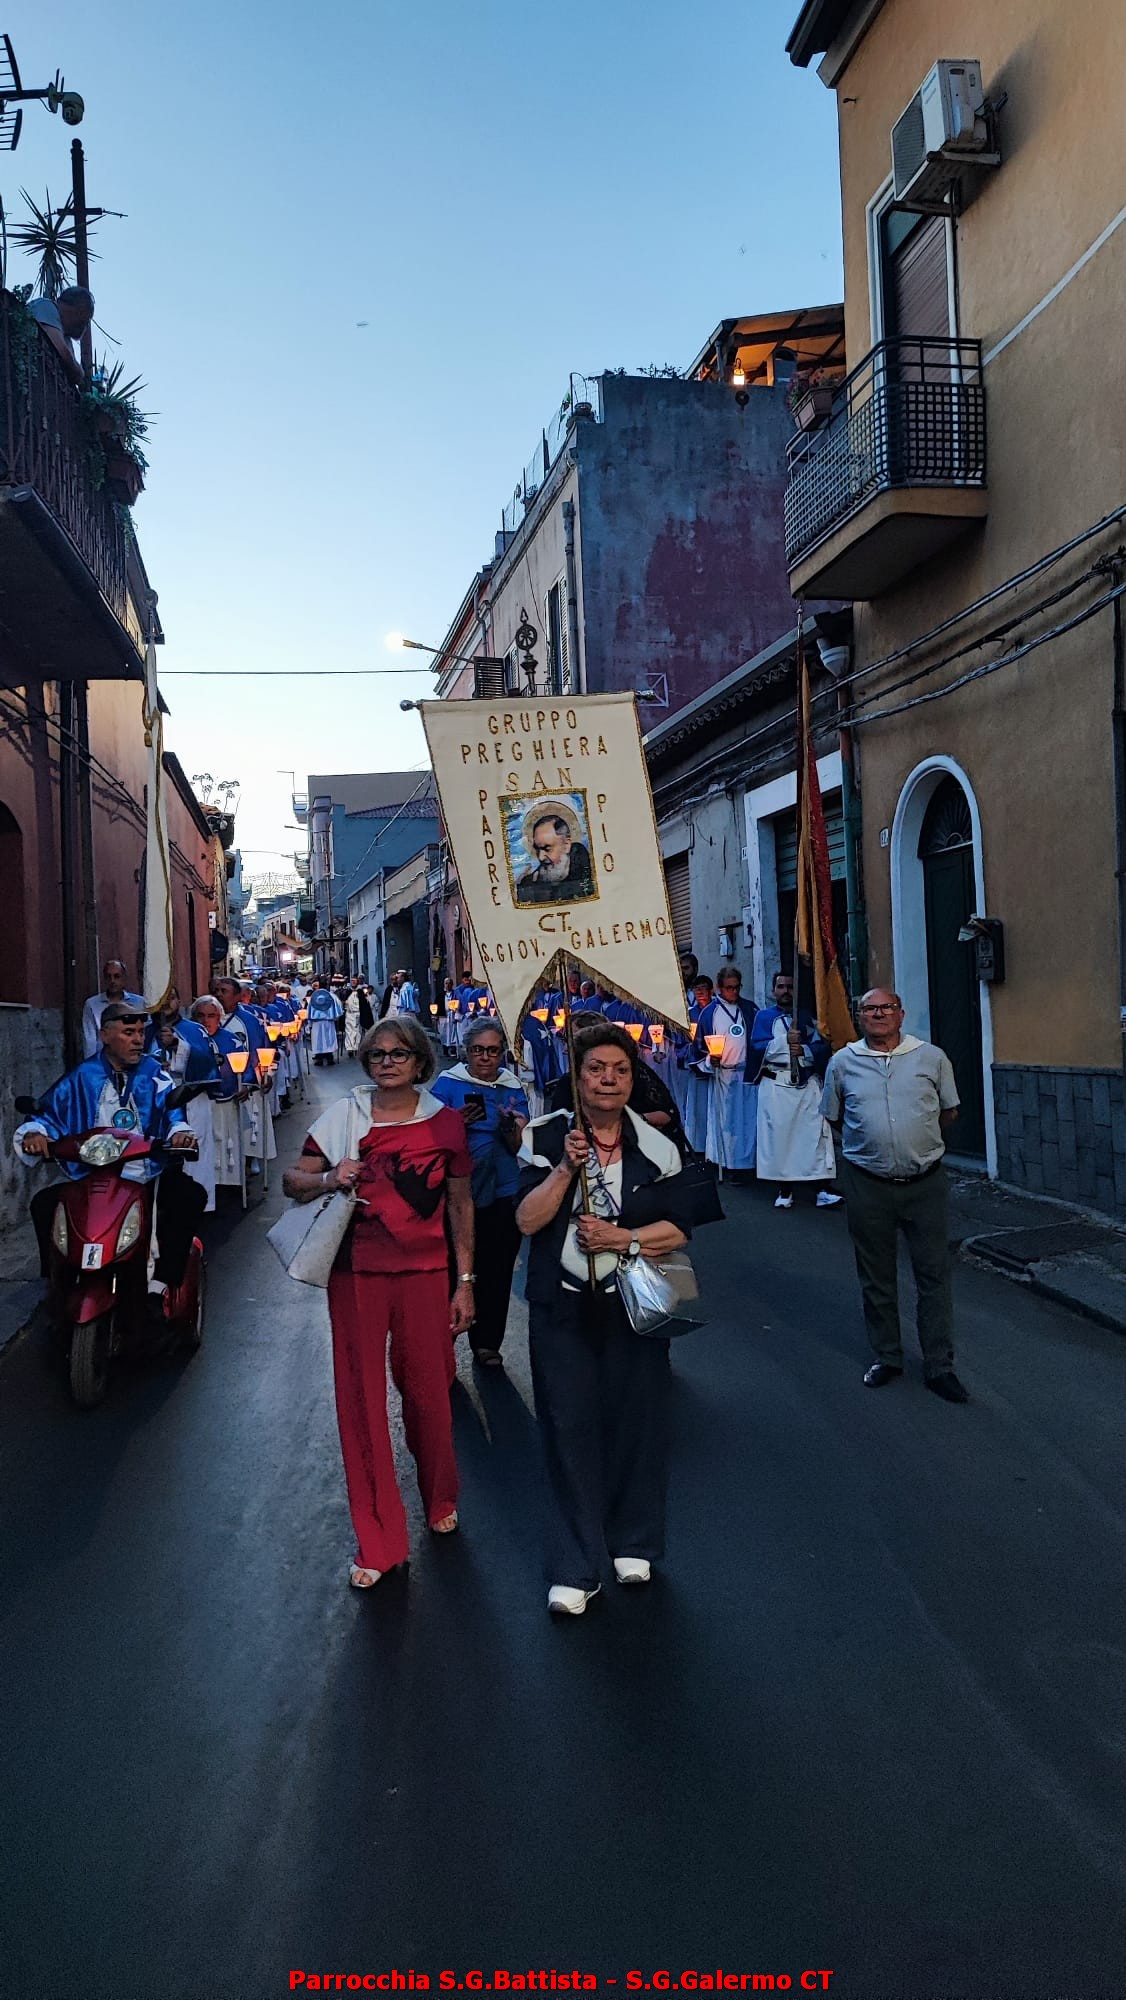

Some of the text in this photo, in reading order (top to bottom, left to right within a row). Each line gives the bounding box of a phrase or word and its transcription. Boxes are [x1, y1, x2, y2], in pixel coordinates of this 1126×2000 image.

[488, 709, 577, 735] GRUPPO
[461, 735, 608, 764] PREGHIERA
[506, 767, 573, 792] SAN
[479, 789, 501, 906] PADRE
[597, 793, 615, 873] PIO
